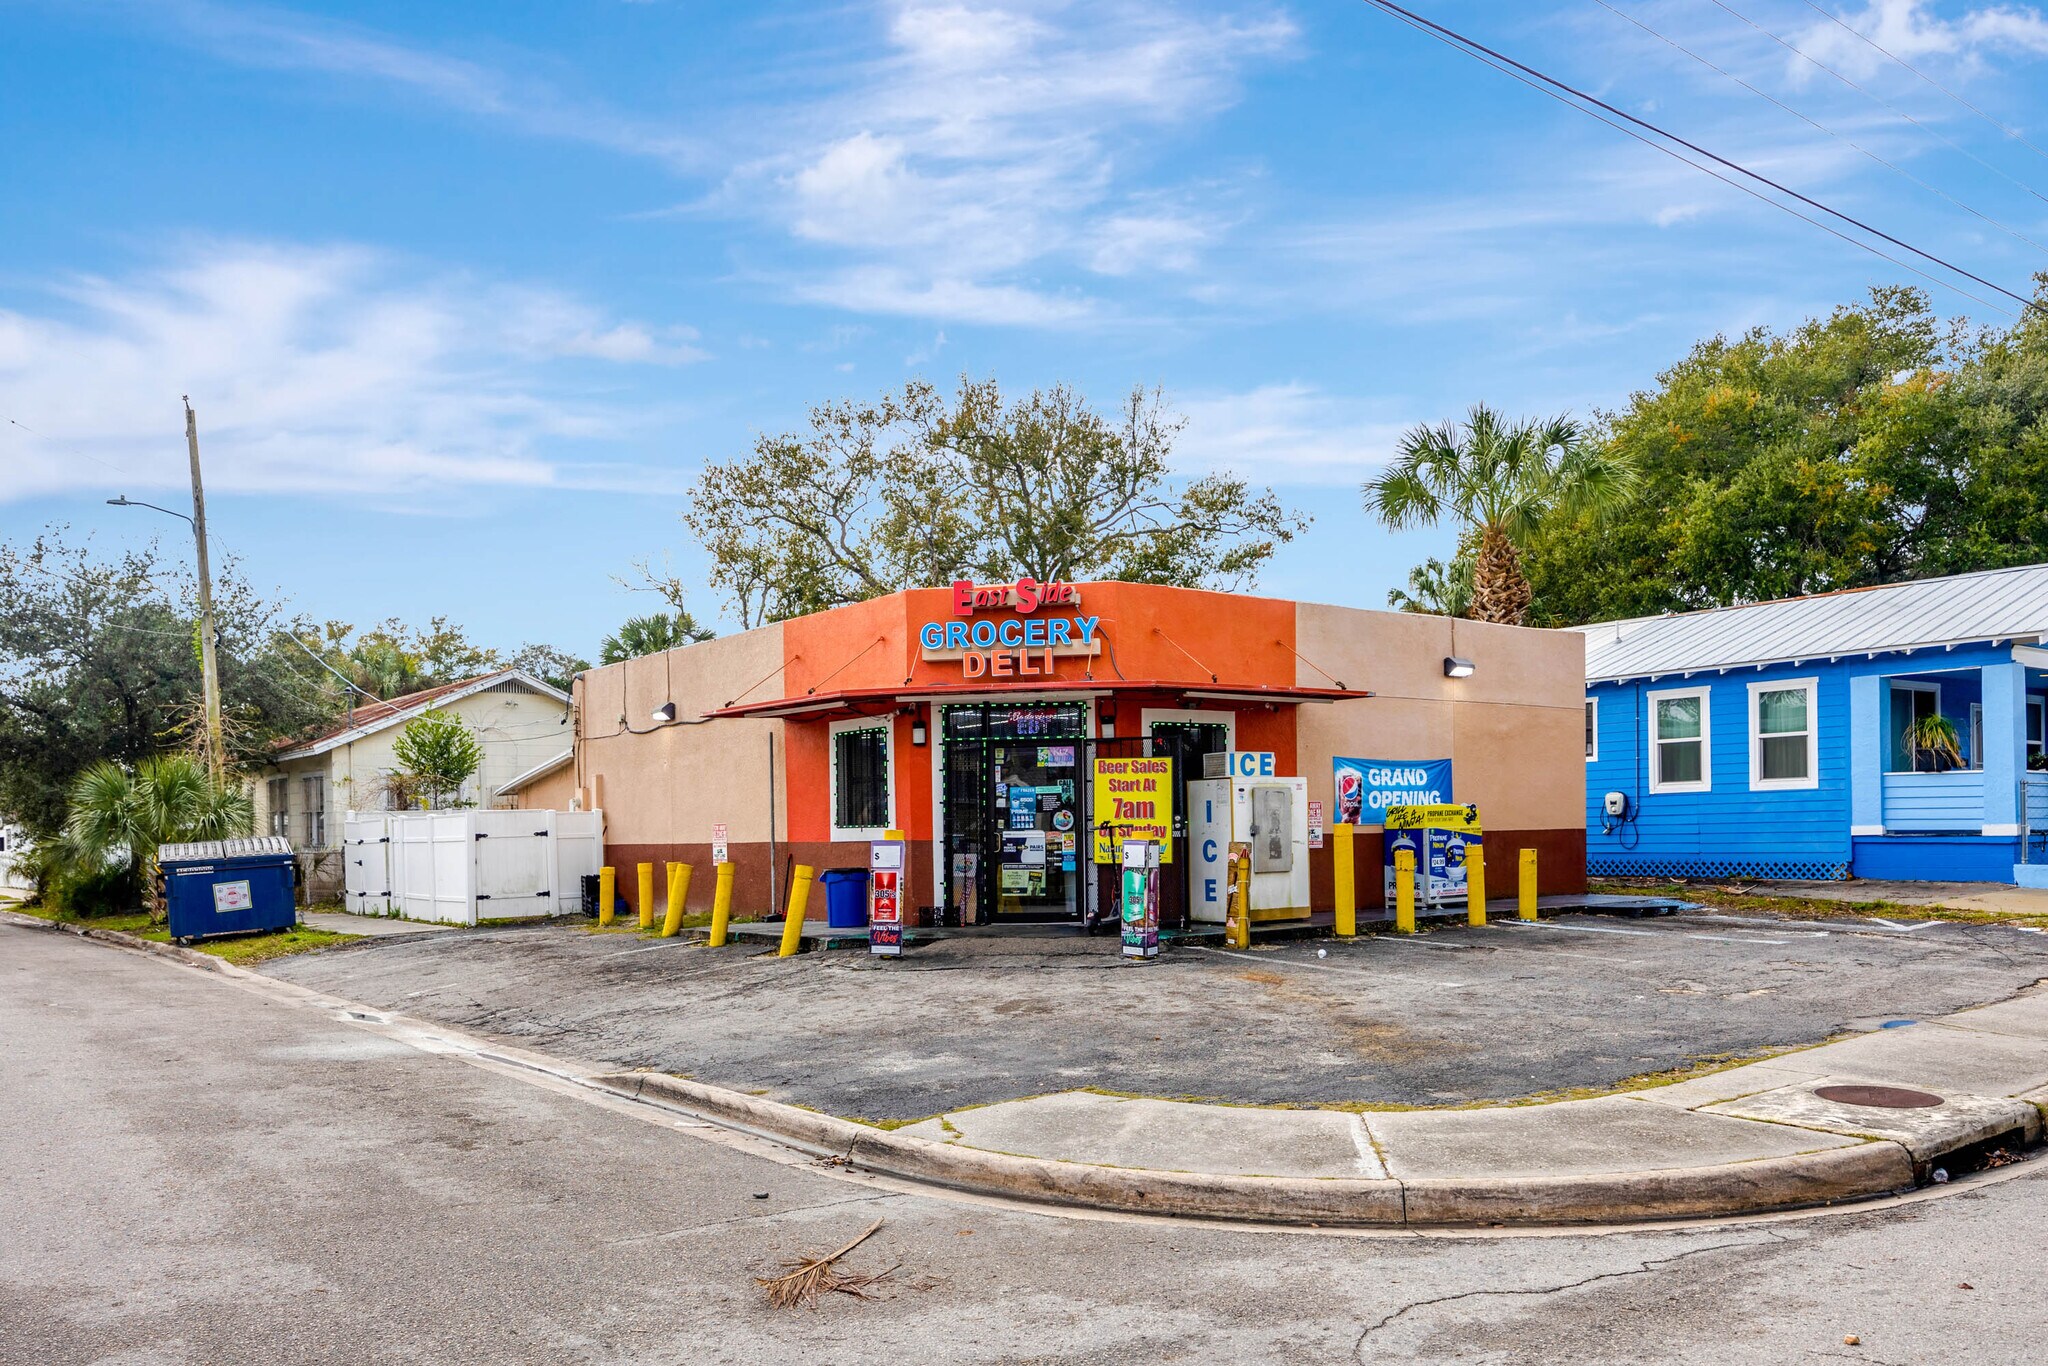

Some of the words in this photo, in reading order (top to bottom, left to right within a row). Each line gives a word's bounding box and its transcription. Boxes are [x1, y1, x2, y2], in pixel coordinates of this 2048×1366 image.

[953, 580, 1010, 616] East
[1015, 577, 1073, 614] Side
[919, 615, 1100, 650] GROCERY
[962, 647, 1055, 678] DELI
[1098, 760, 1130, 774] Beer
[1131, 759, 1168, 774] Sales
[1229, 752, 1273, 777] ICE
[1108, 778, 1141, 792] Start
[1142, 778, 1157, 792] At
[1368, 768, 1428, 786] GRAND
[1112, 797, 1155, 820] 7am
[1368, 790, 1441, 809] OPENING
[1427, 809, 1444, 817] PROPANE
[1444, 808, 1464, 817] EXCHANGE
[874, 852, 880, 861] $
[1124, 851, 1130, 860] $
[1202, 799, 1218, 902] ICE
[874, 888, 897, 899] 305's
[873, 930, 899, 944] Vibes
